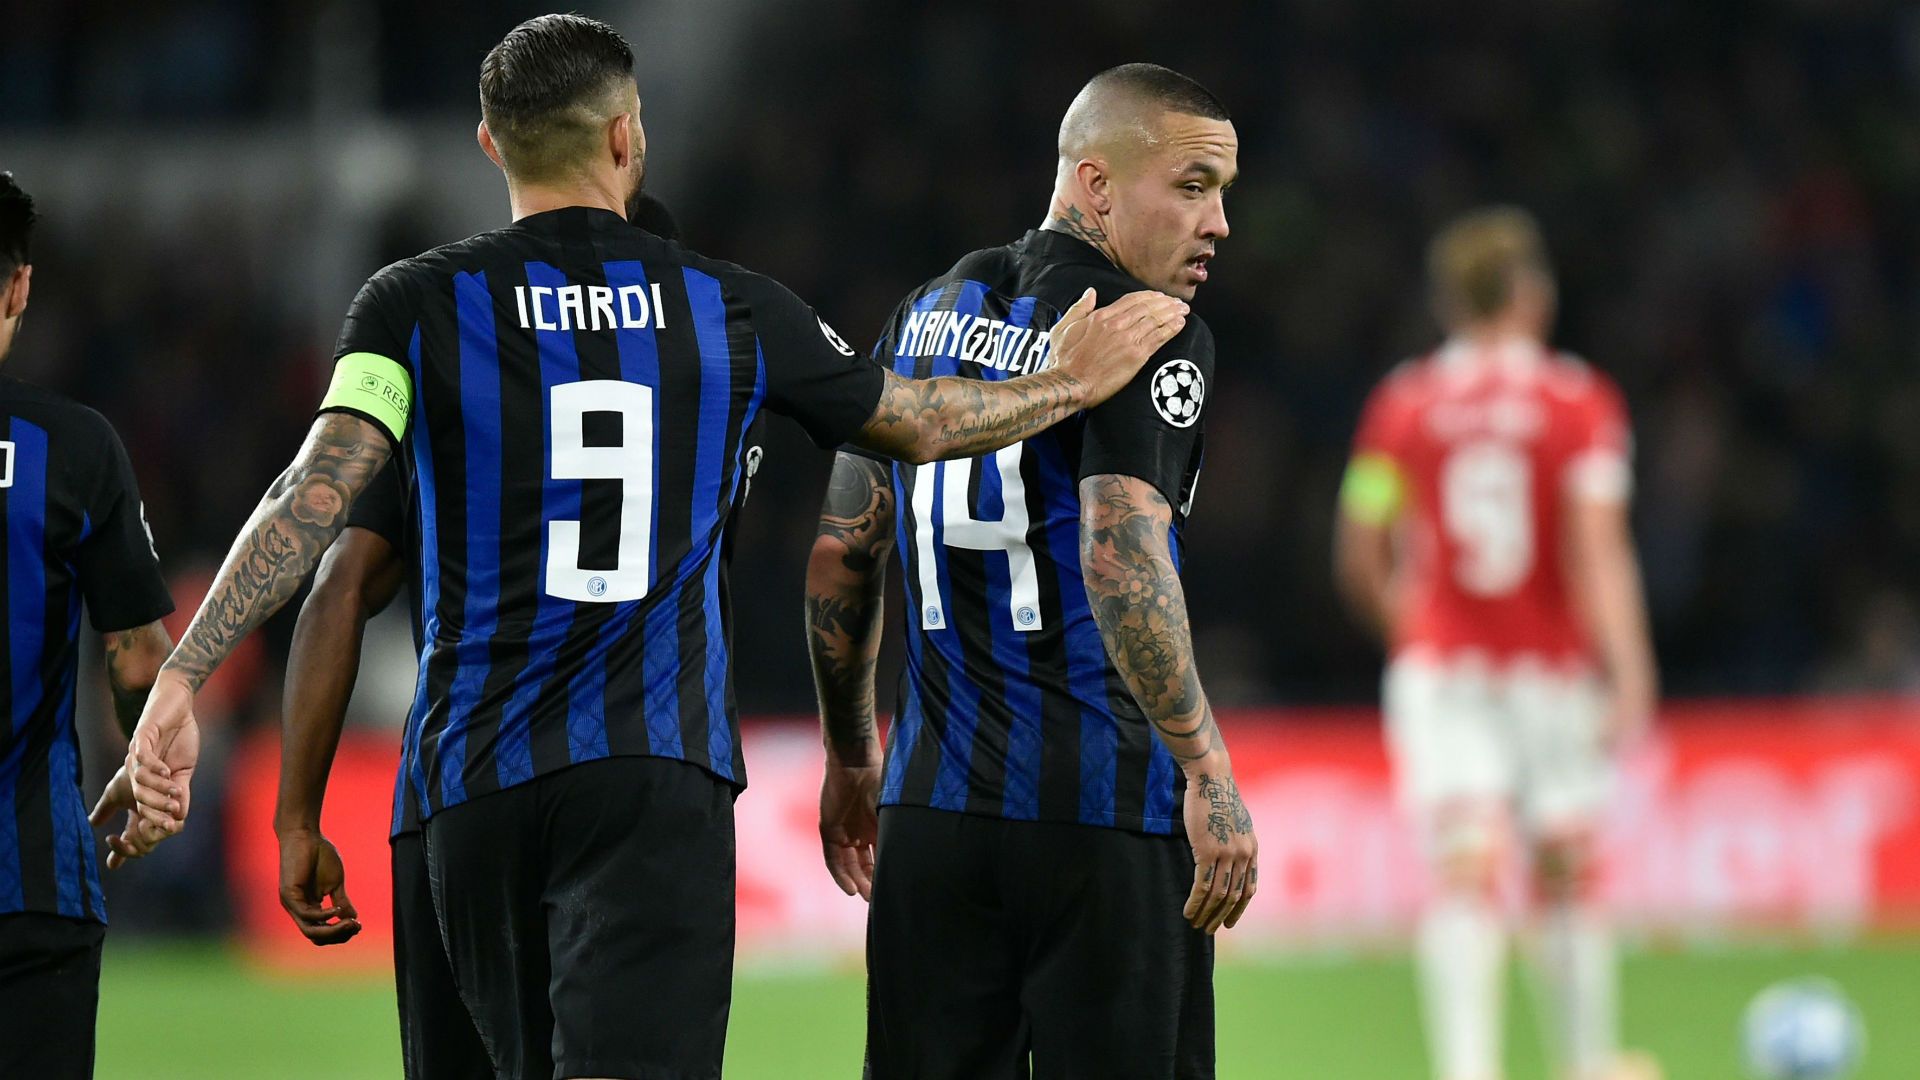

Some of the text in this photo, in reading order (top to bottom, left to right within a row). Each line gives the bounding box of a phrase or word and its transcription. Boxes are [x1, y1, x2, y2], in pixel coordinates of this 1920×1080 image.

[514, 283, 666, 331] ICARDI
[896, 310, 1051, 375] NAINGGOLA
[545, 380, 653, 603] 9
